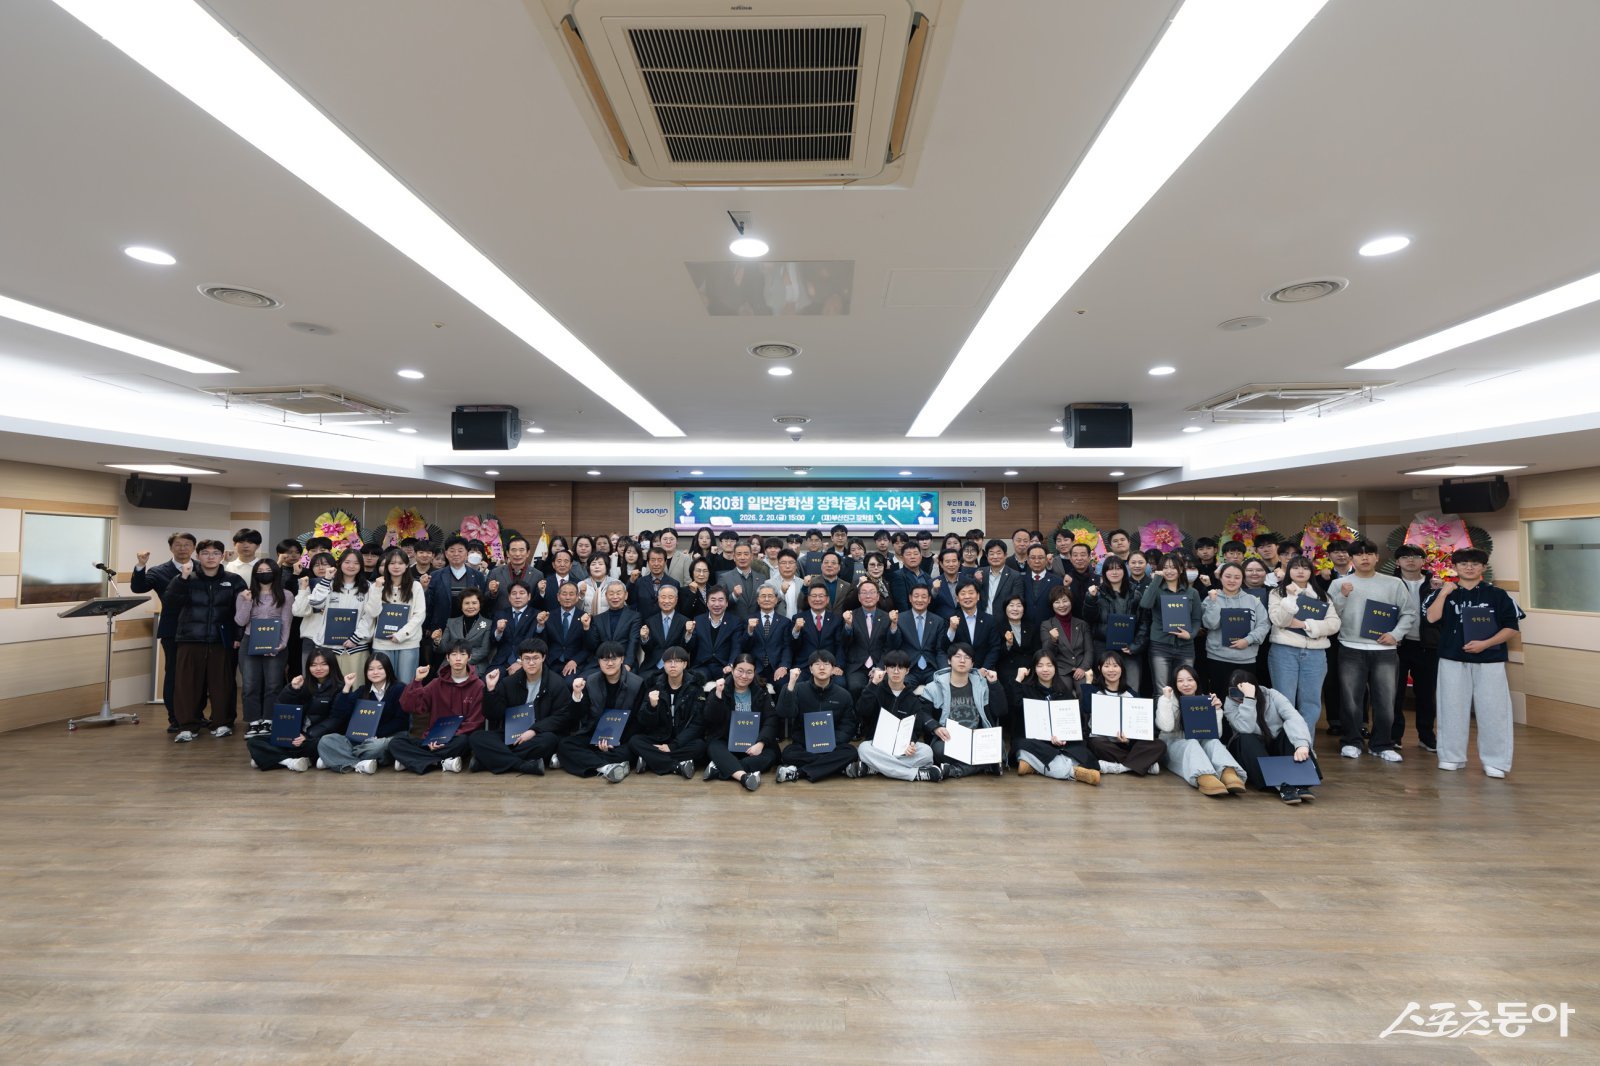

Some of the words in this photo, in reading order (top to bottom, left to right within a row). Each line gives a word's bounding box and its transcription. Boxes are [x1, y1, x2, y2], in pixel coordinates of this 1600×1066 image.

[699, 496, 744, 511] 제30회
[747, 496, 814, 511] 일반장학생
[817, 496, 870, 511] 장학증서
[874, 496, 914, 511] 수여식
[636, 507, 669, 518] busanjin
